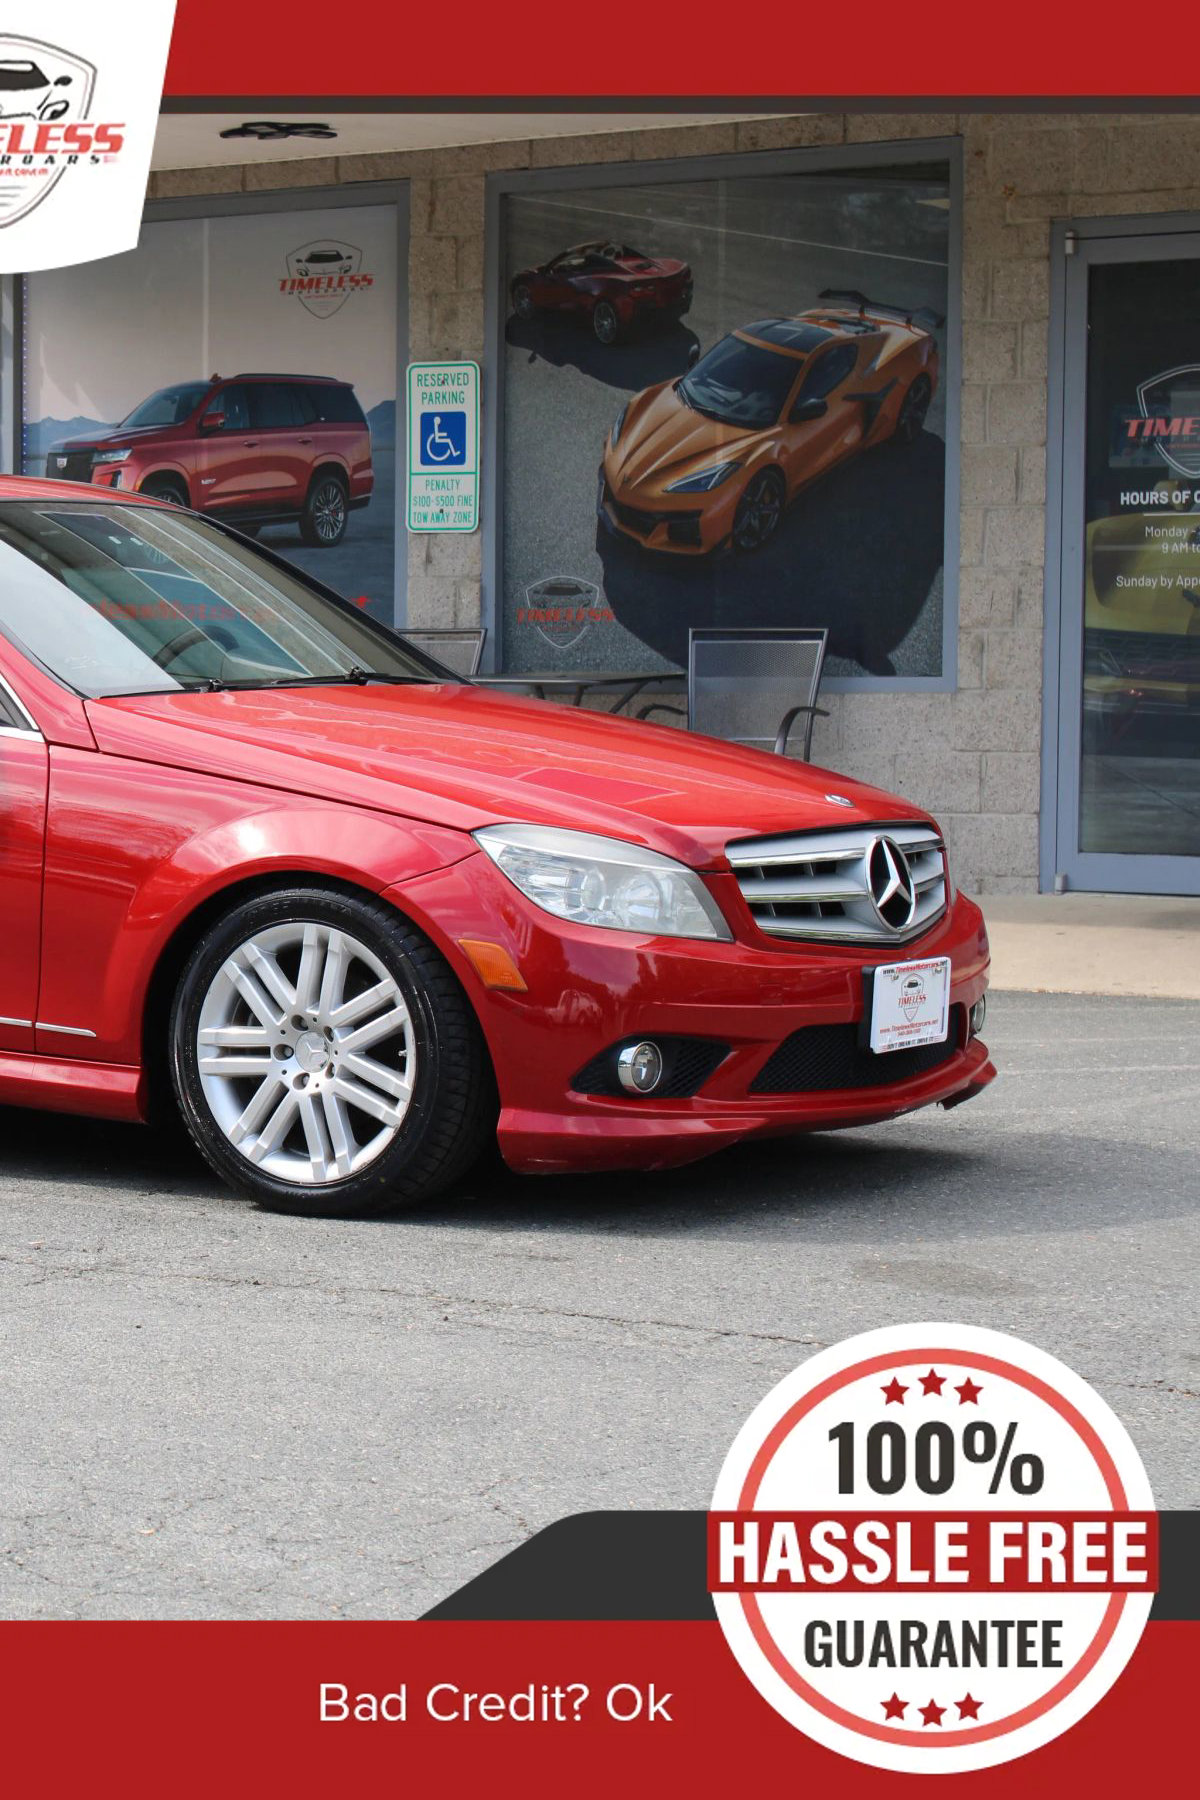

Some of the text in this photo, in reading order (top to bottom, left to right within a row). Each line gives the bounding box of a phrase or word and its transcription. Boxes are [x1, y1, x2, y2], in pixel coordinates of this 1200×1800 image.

[278, 273, 375, 291] TIMELESS
[416, 373, 469, 387] RESERVED
[421, 390, 465, 405] PARKING
[425, 479, 460, 491] PENALTY
[457, 495, 472, 507] FINE
[1120, 491, 1168, 506] HOURS
[1171, 490, 1191, 505] OF
[413, 511, 472, 523] TOW AWAY ZONE
[1145, 526, 1188, 539] Monday
[1171, 541, 1189, 554] AM
[1116, 575, 1158, 589] Sunday
[1161, 575, 1173, 589] by
[898, 994, 927, 1007] TIMELESS
